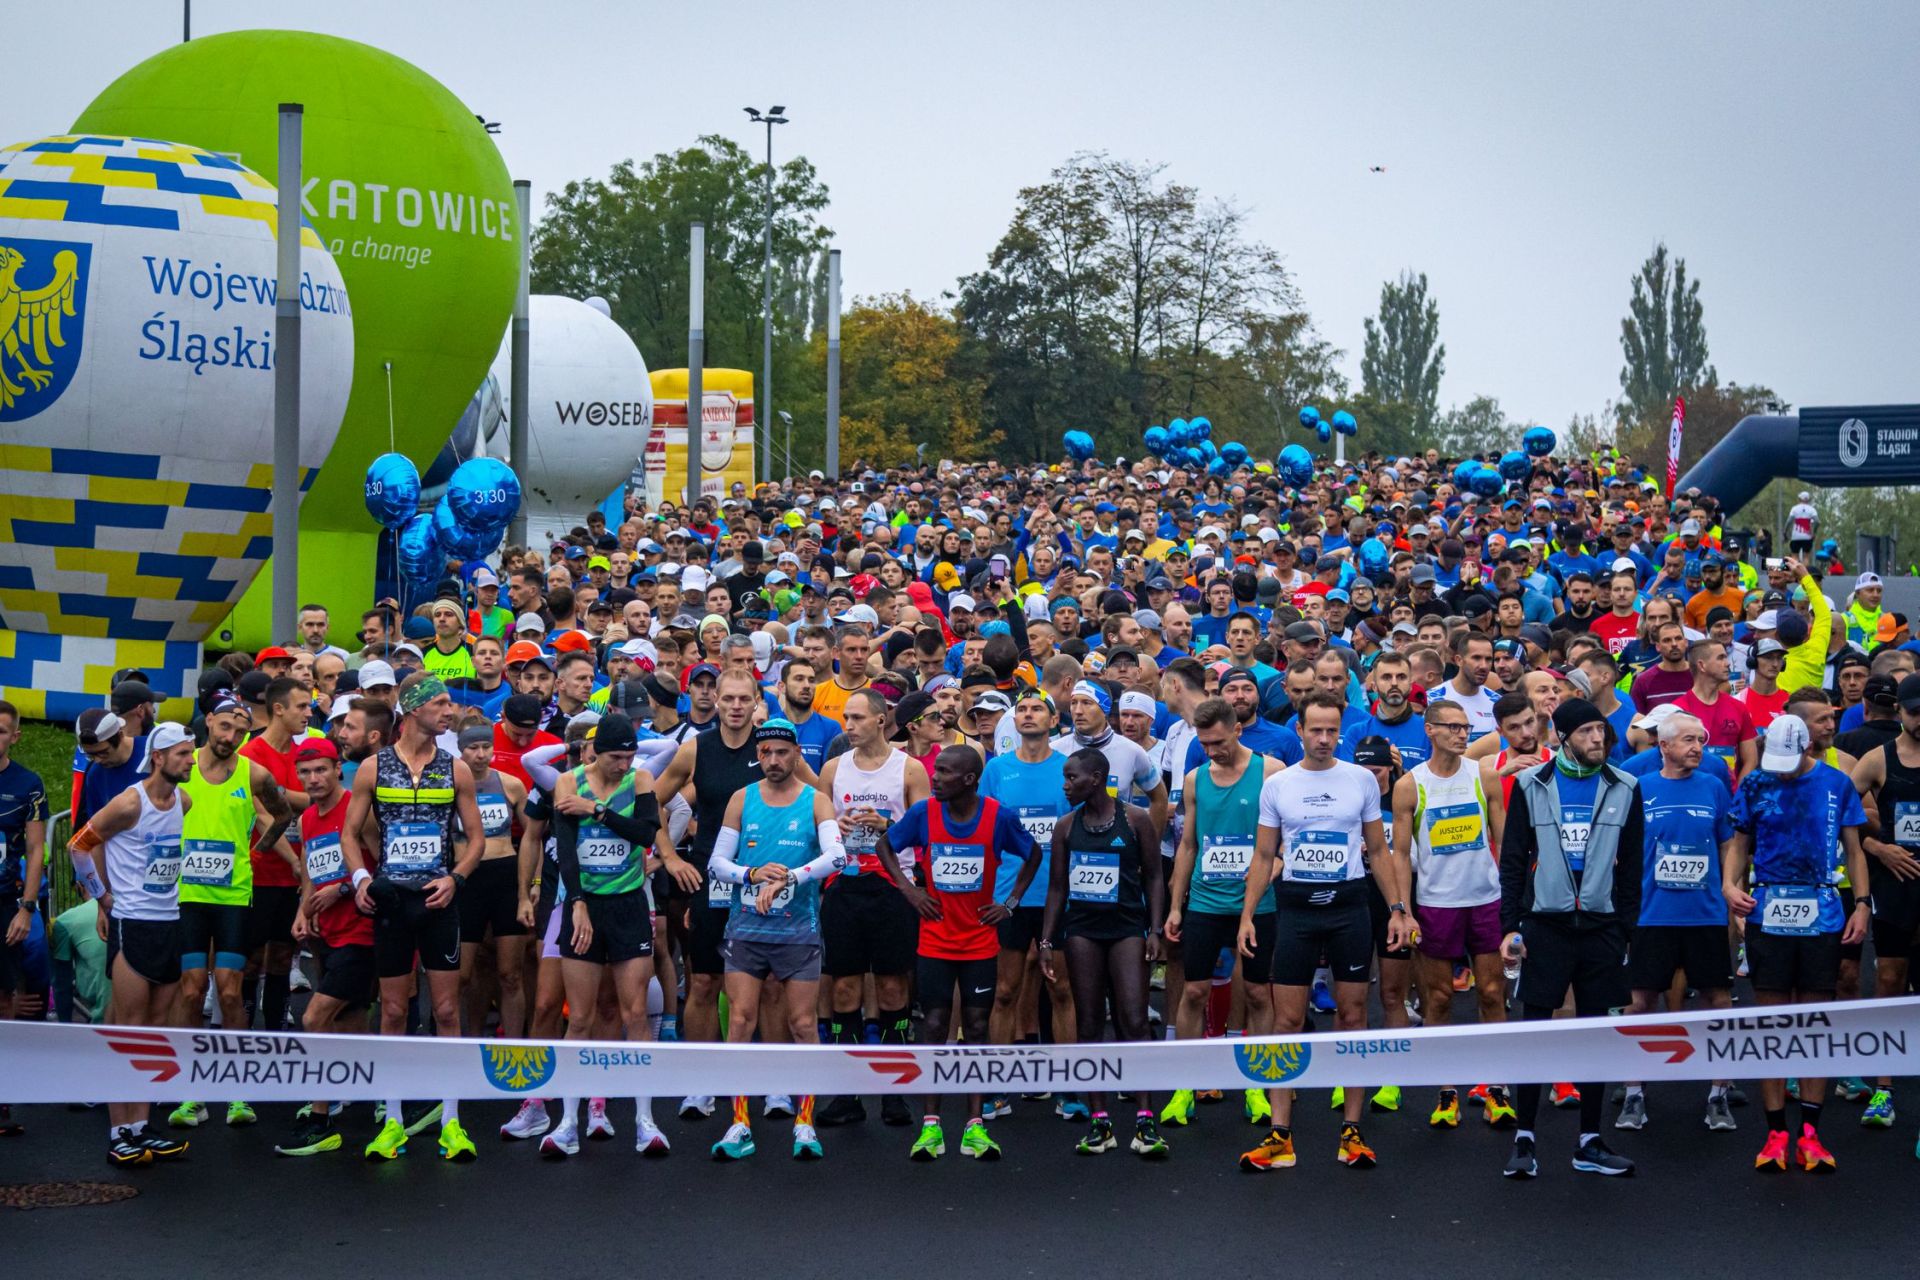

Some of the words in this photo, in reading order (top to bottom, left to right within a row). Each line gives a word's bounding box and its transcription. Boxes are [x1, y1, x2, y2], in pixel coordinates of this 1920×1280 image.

[300, 176, 513, 242] KATOWICE
[351, 236, 432, 270] change
[142, 255, 352, 318] Wojewdztw
[555, 400, 650, 426] WOSEBA
[1877, 428, 1919, 442] STADION
[1877, 442, 1911, 458] ŚLĄSKI
[474, 488, 506, 504] 3:30
[755, 730, 792, 738] absotec
[852, 792, 889, 803] badaj.to
[480, 808, 506, 821] 441
[390, 841, 437, 856] A1951
[1294, 849, 1344, 864] A2040
[185, 856, 230, 870] A1599
[308, 850, 340, 871] A1278
[1209, 851, 1245, 864] A211
[148, 861, 182, 877] A2197
[1659, 859, 1705, 874] A1979
[1771, 904, 1810, 918] A579
[191, 1034, 308, 1055] SILESIA
[1706, 1029, 1907, 1063] MARATHON
[578, 1046, 653, 1071] Śląskie
[189, 1059, 376, 1086] MARATHON
[932, 1056, 1124, 1085] MARATHON
